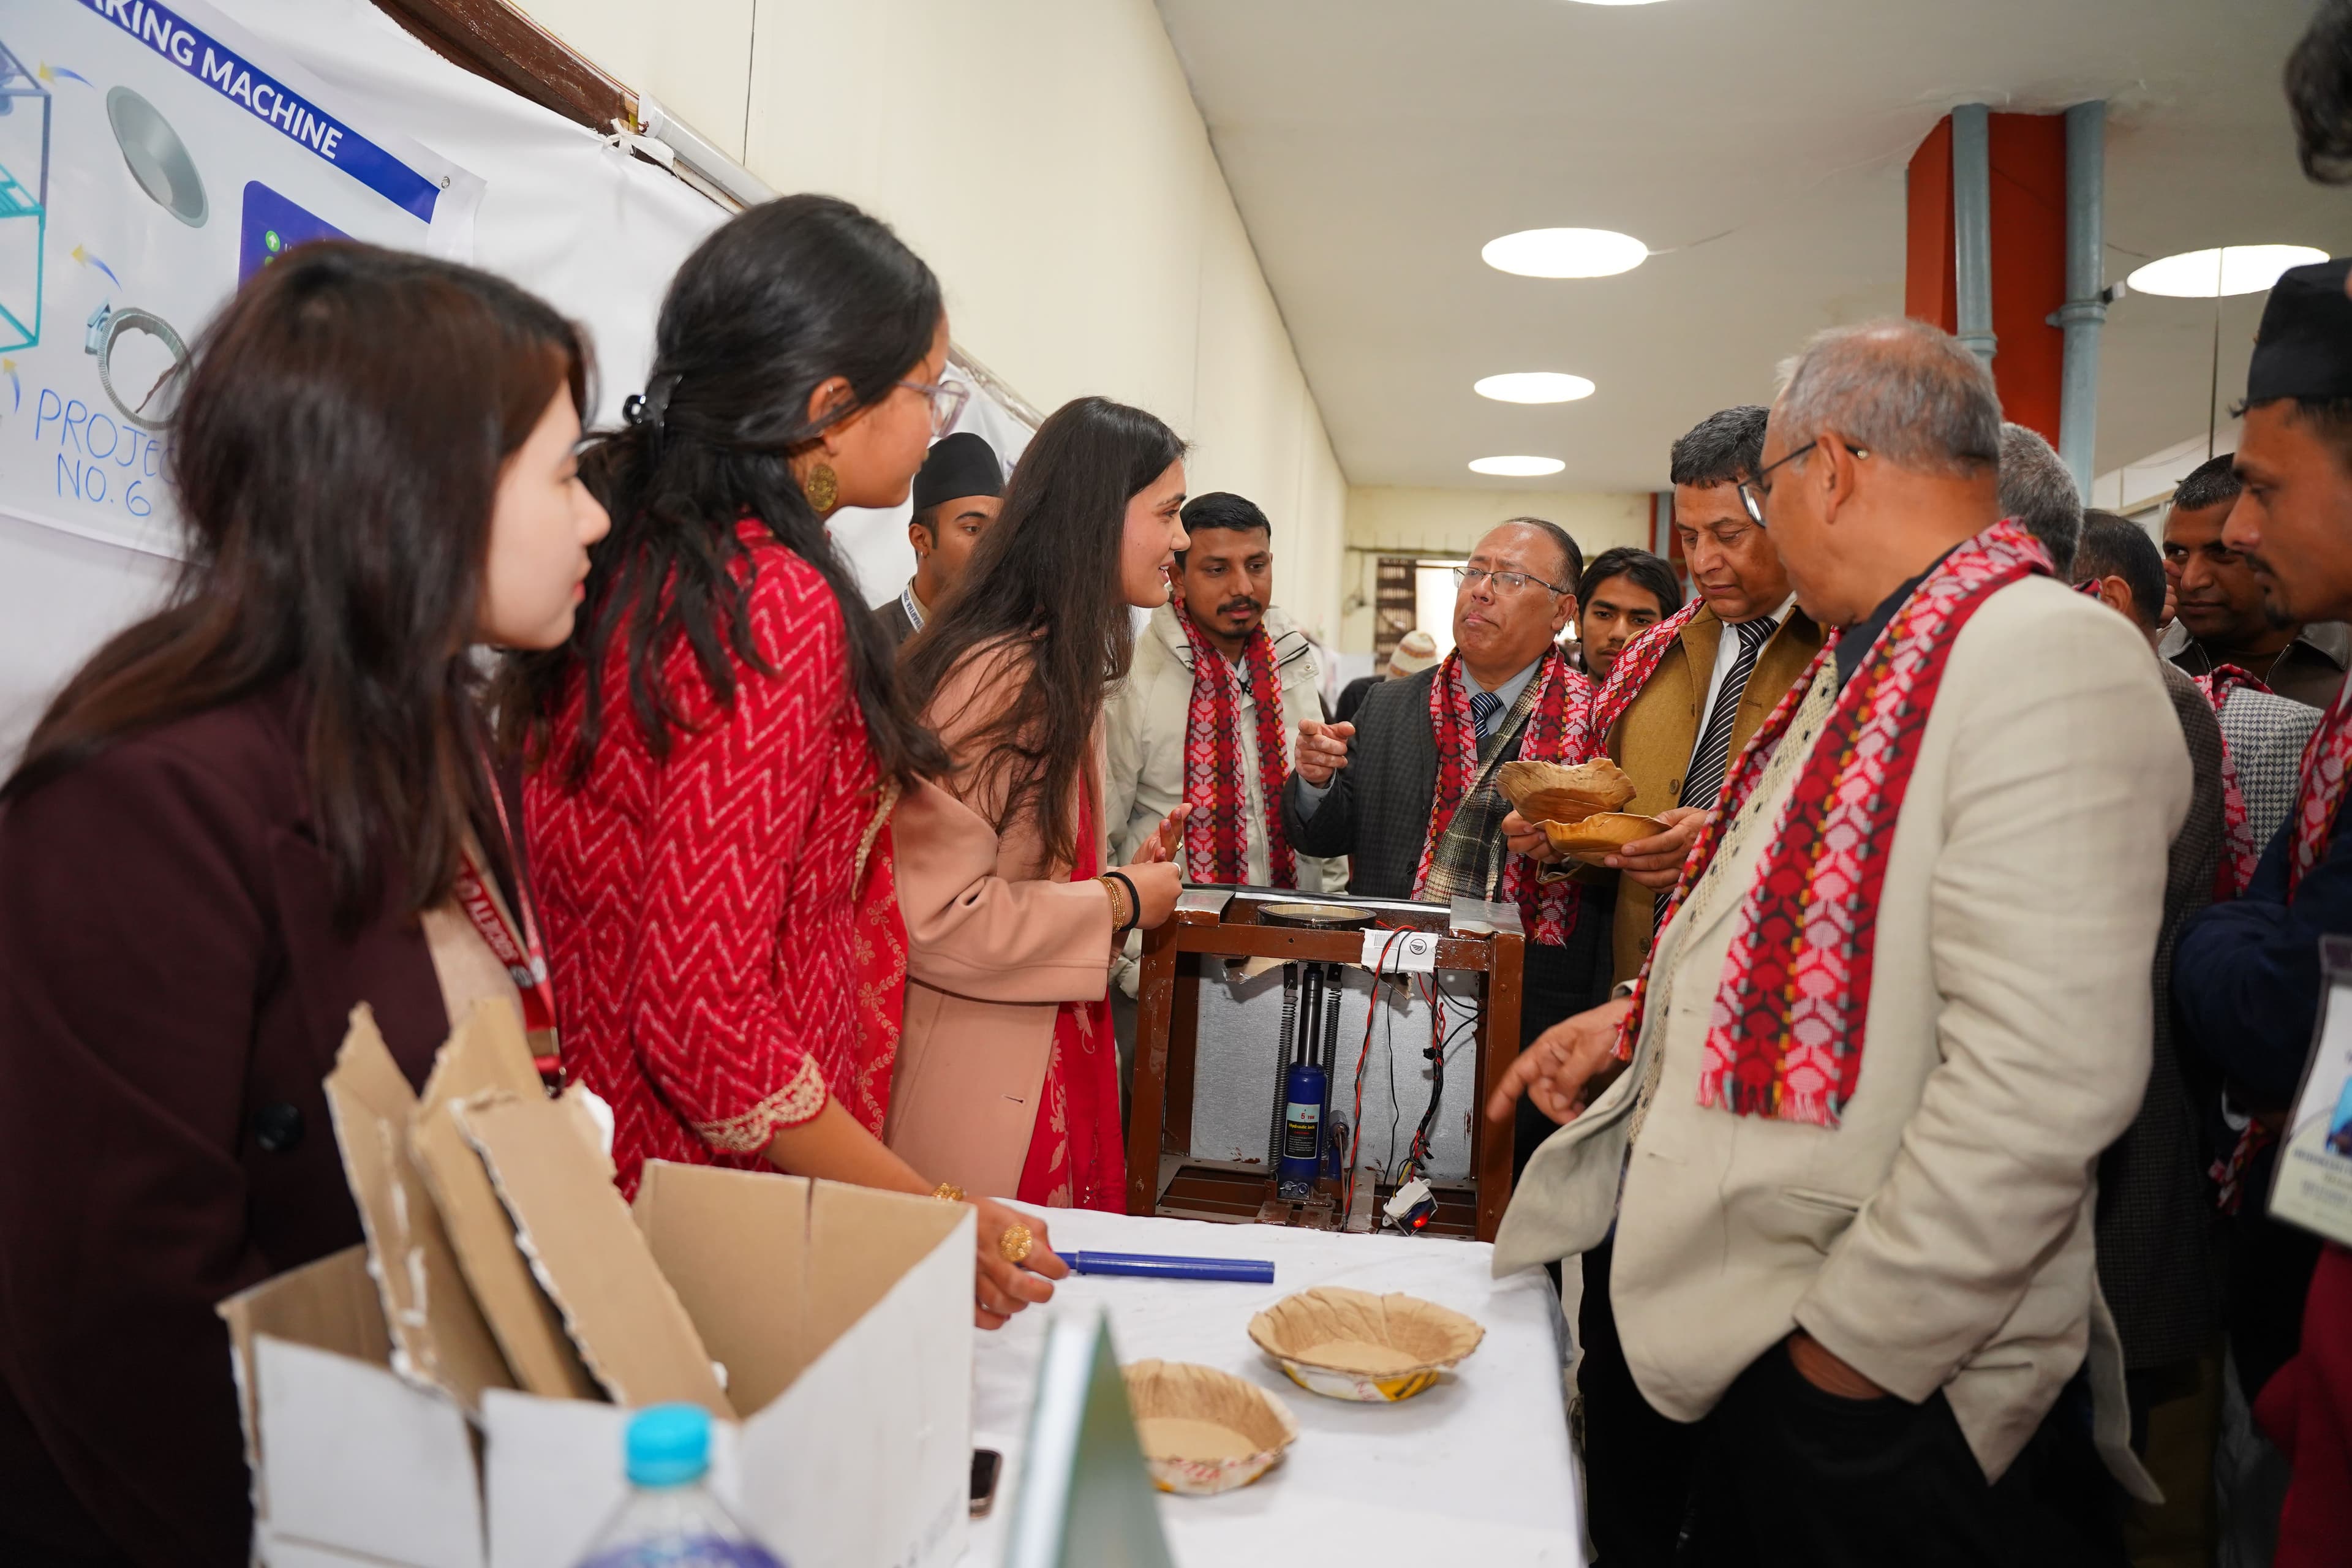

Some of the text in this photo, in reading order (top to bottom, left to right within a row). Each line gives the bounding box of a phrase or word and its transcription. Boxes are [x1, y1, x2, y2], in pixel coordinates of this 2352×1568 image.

[94, 0, 344, 160] KING MACHINE
[35, 388, 178, 486] PROJEC
[58, 453, 151, 516] NO. 6
